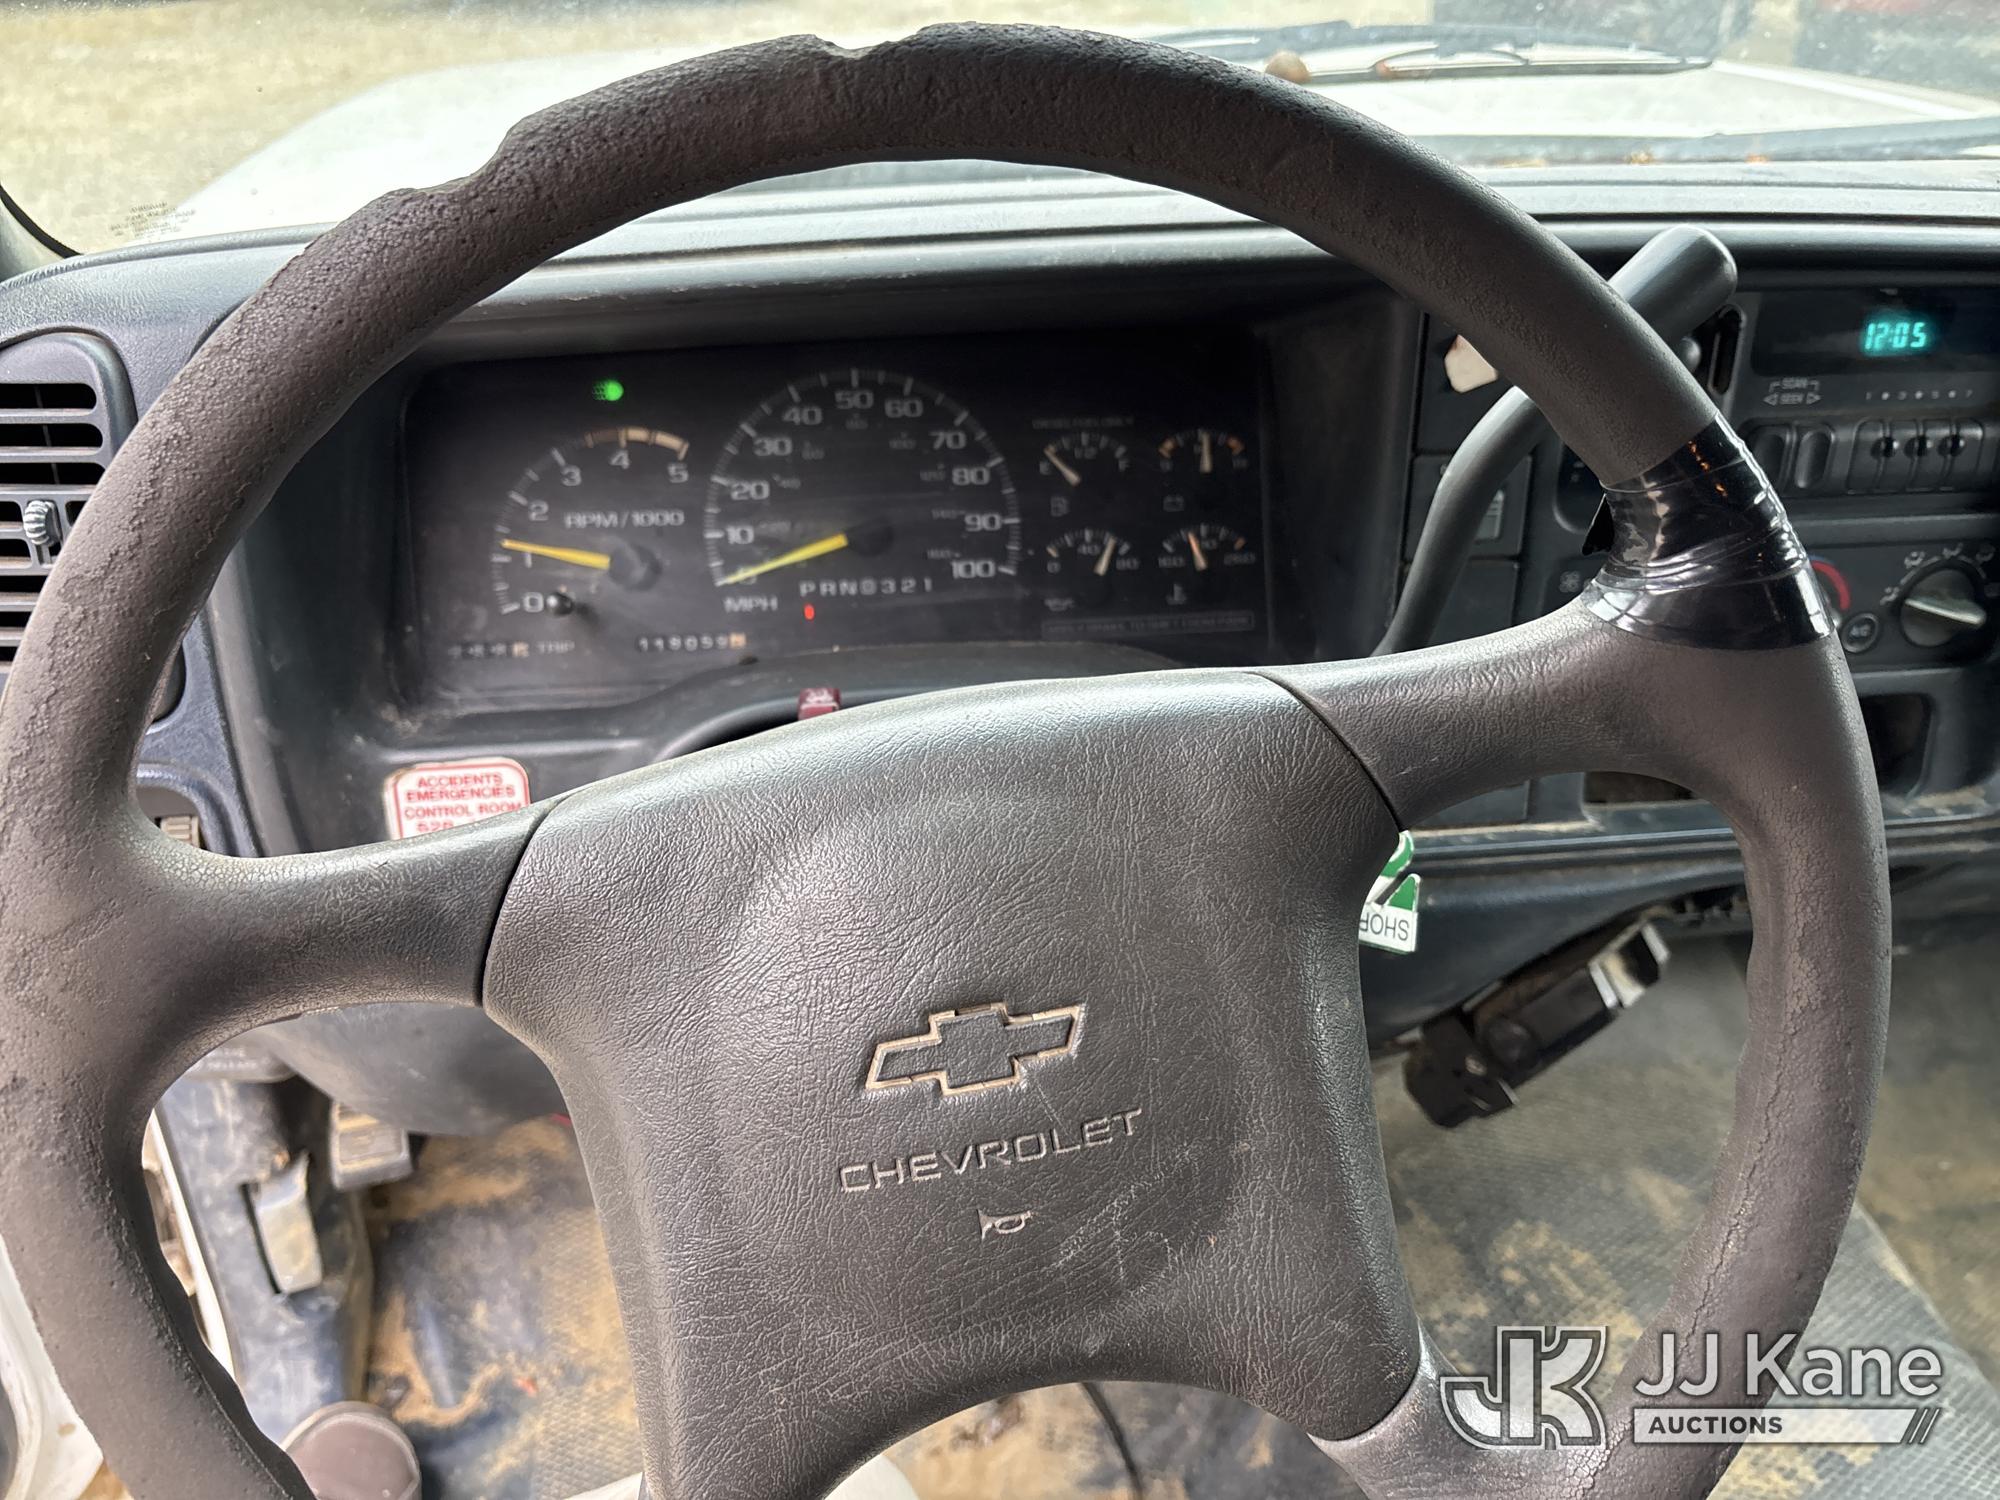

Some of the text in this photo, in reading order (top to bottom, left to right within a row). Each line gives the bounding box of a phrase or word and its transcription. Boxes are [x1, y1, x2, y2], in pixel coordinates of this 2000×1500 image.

[1865, 322, 1926, 349] 12:05
[835, 390, 874, 409] 50
[884, 399, 923, 418] 60
[781, 406, 823, 425] 40
[754, 437, 793, 456] 30
[929, 430, 966, 449] 70
[610, 451, 631, 469] 4
[561, 466, 582, 486] 3
[668, 463, 689, 483] 5
[951, 466, 991, 485] 80
[731, 481, 770, 500] 20
[529, 502, 549, 521] 2
[564, 510, 685, 528] RPM/1000
[964, 513, 1001, 531] 90
[726, 526, 754, 544] 10
[952, 560, 995, 578] 100
[523, 592, 544, 613] 0
[724, 596, 778, 612] MPH
[417, 772, 504, 788] ACCIDENTS
[406, 785, 516, 802] EMERGENCIES
[404, 801, 522, 819] CONTROL ROOM
[840, 1108, 1142, 1193] CHEVROLET
